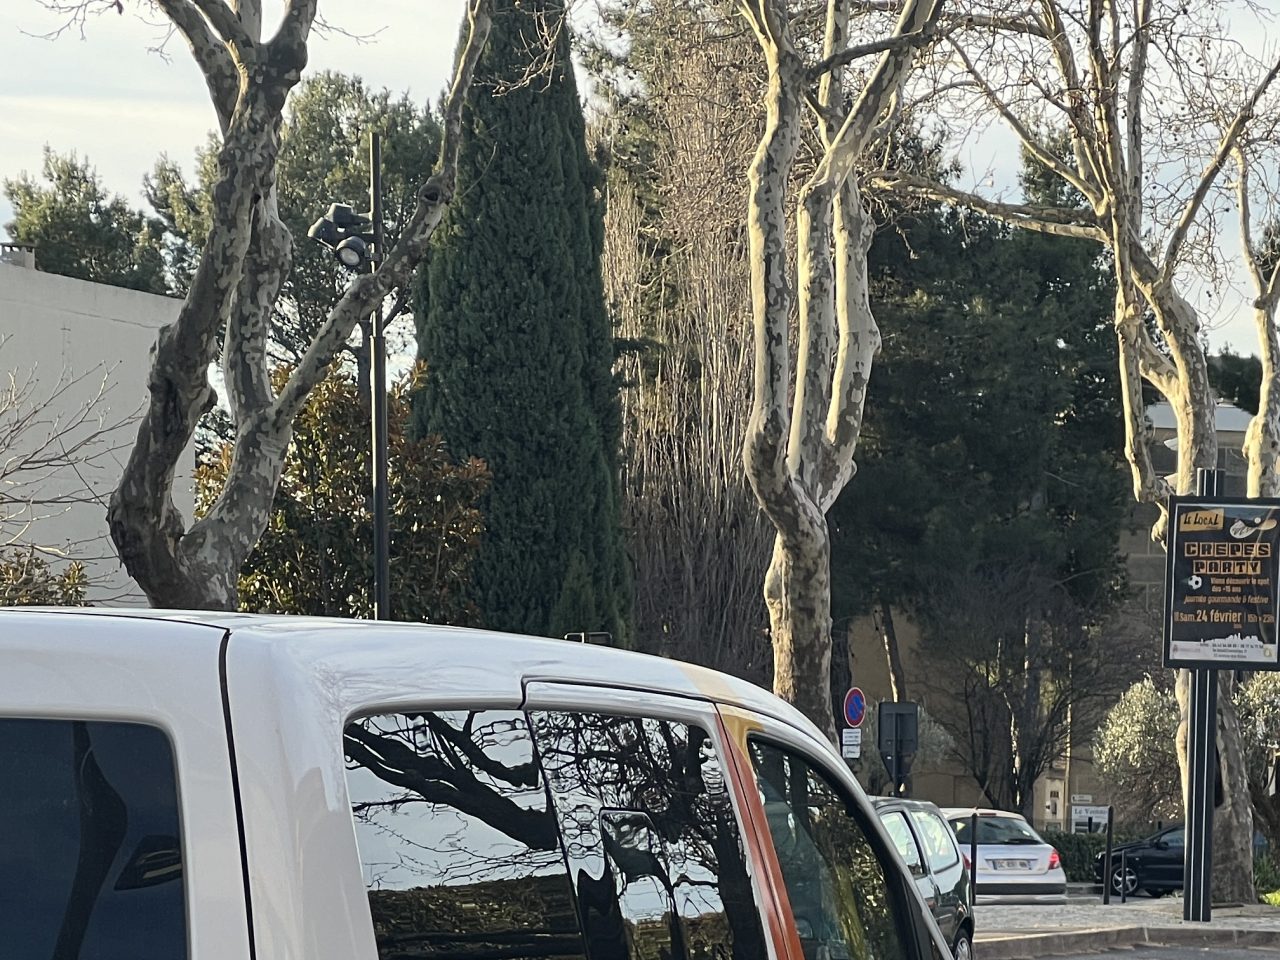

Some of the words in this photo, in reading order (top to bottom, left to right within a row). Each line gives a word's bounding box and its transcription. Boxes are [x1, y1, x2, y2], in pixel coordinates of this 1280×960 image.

[1185, 542, 1270, 556] CREPES
[1194, 561, 1260, 573] PARTY
[1197, 610, 1207, 622] 24
[1210, 609, 1242, 622] février
